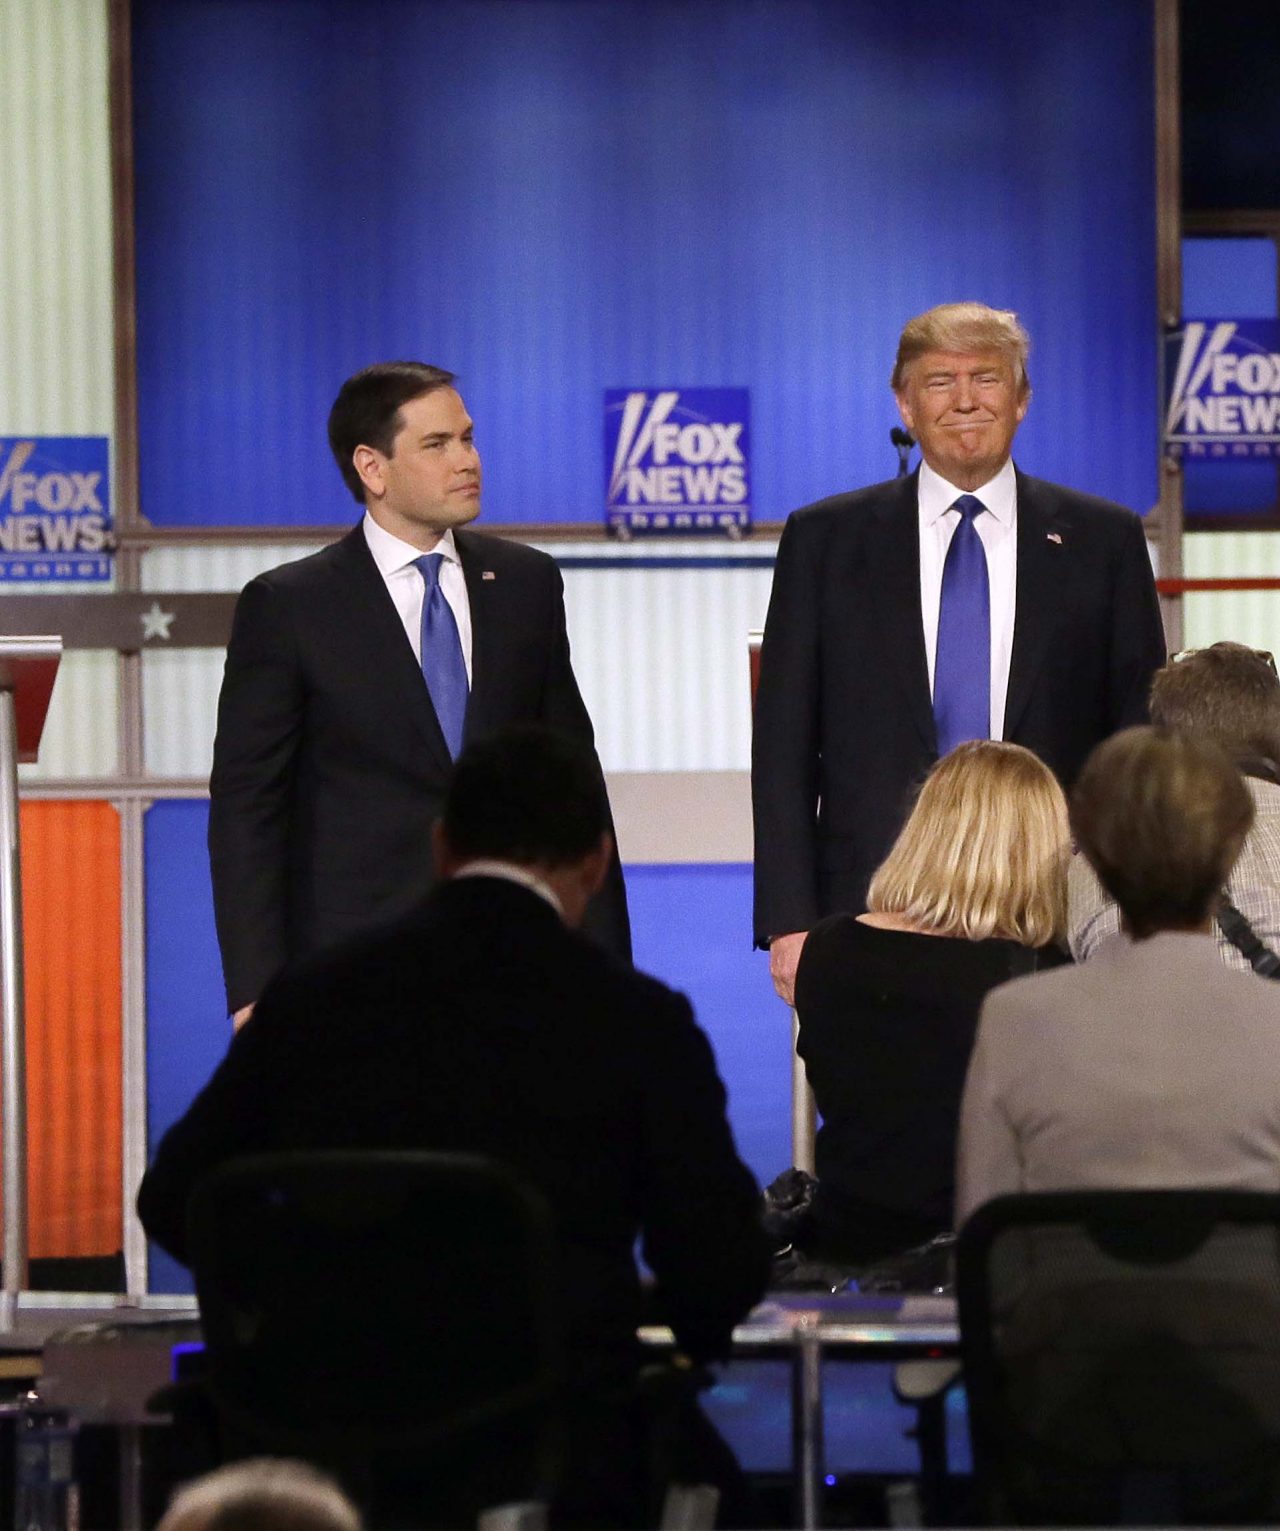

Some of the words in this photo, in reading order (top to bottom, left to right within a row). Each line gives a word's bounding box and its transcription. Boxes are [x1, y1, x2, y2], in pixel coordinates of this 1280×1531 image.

[652, 422, 744, 465] FOX
[12, 471, 103, 513] FOX
[627, 465, 747, 503] NEWS
